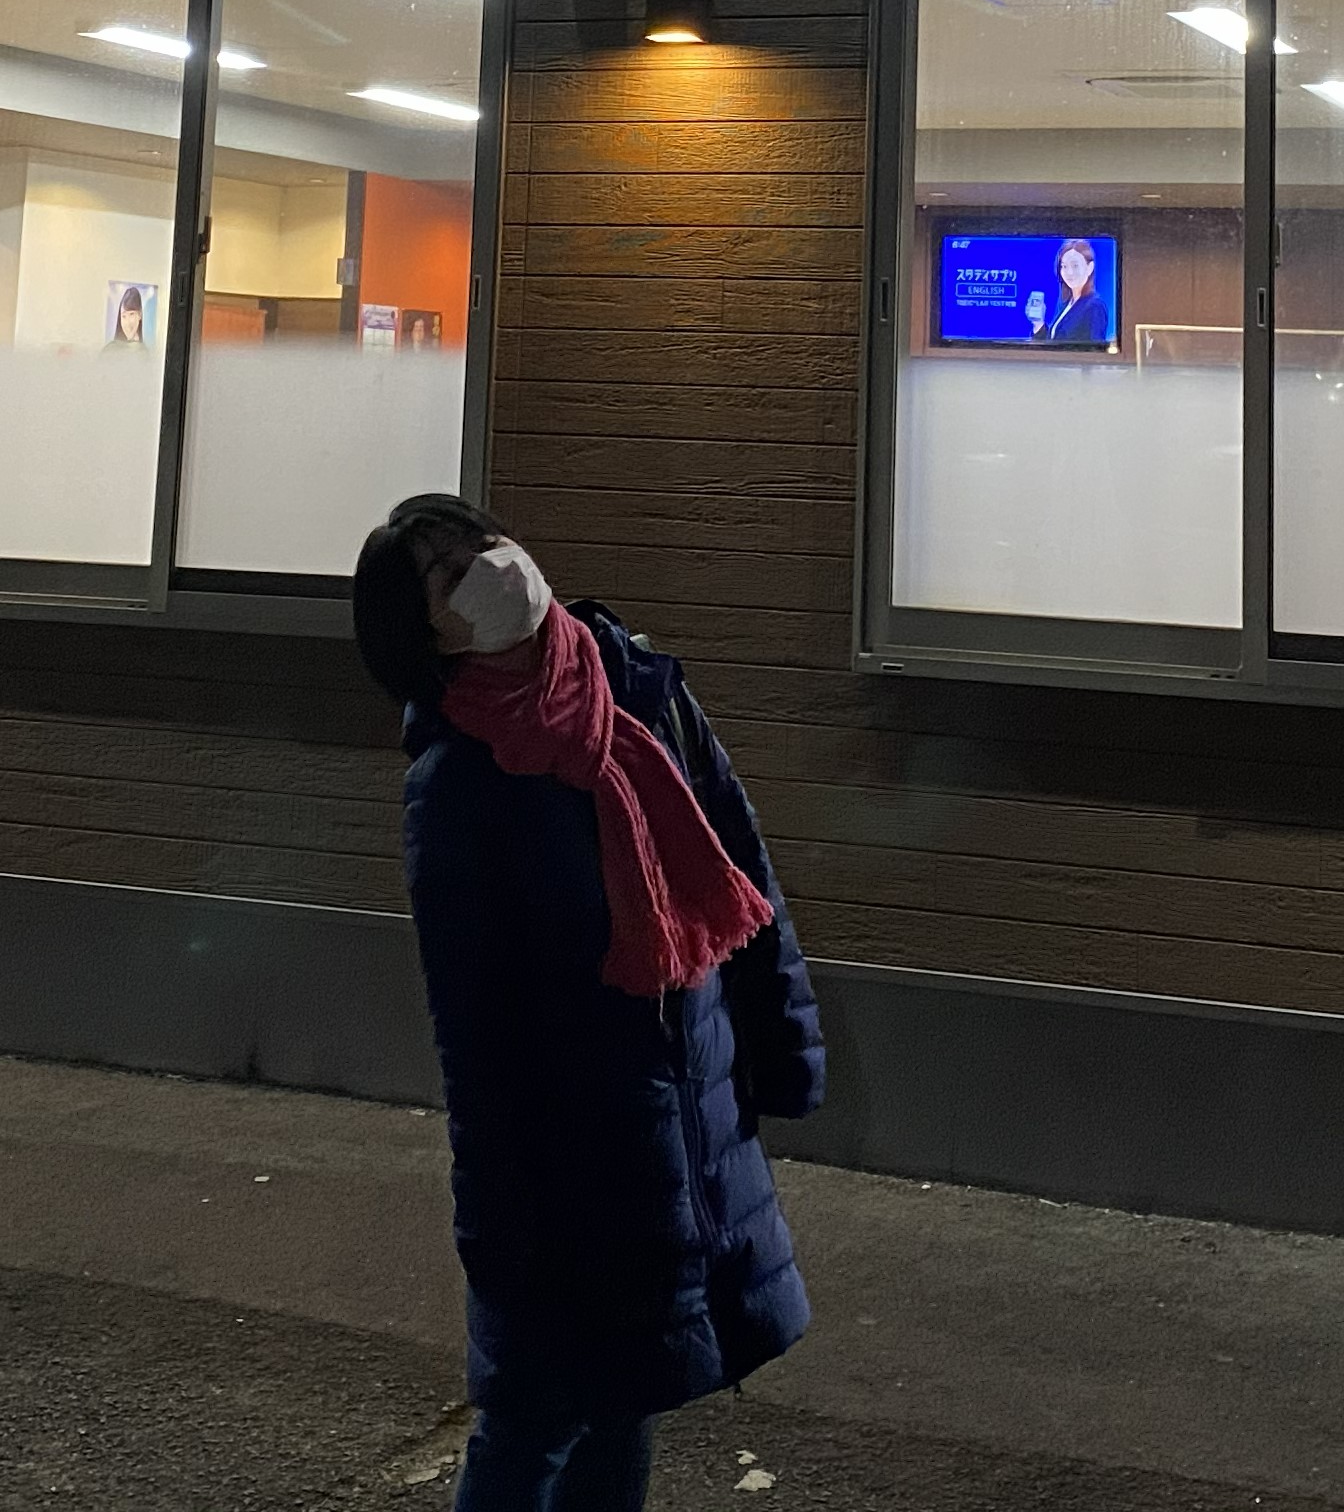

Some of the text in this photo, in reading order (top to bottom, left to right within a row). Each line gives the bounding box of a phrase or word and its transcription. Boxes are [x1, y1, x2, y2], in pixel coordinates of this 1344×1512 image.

[956, 269, 1017, 281] スタディサプリ
[968, 286, 1005, 295] ENGLISH
